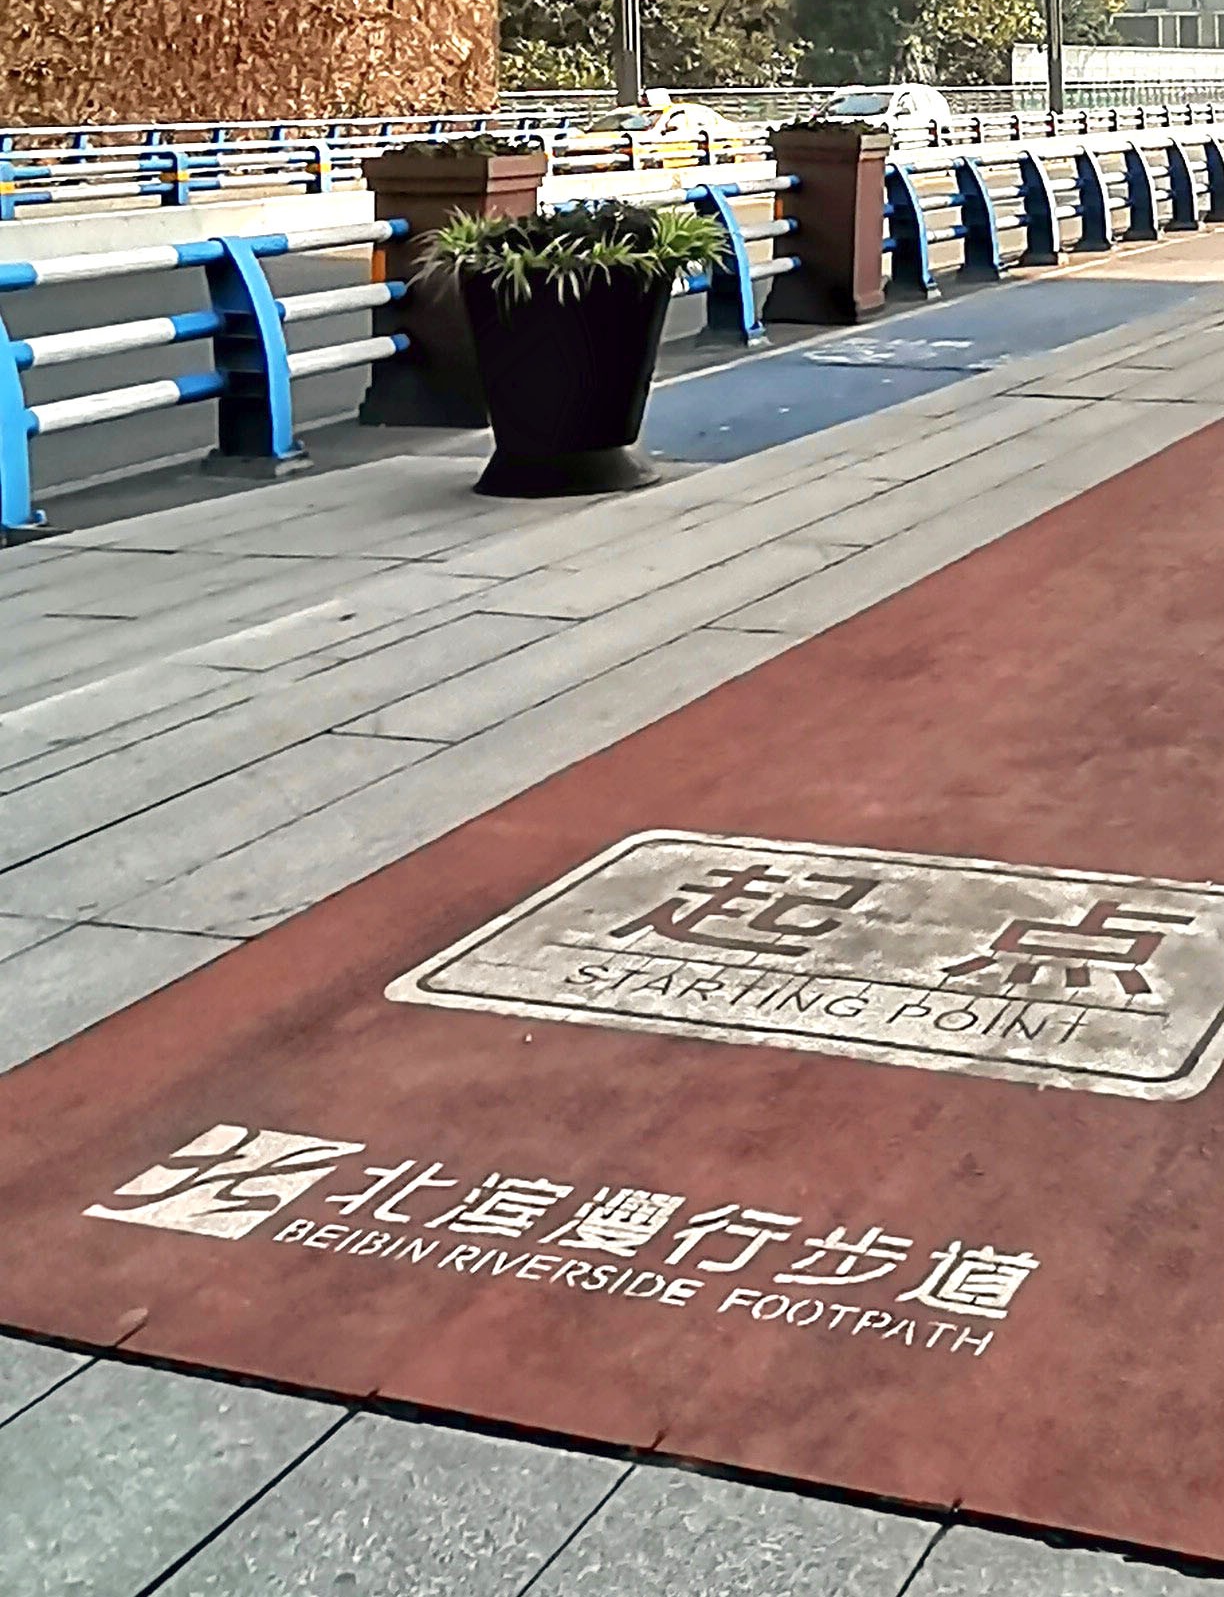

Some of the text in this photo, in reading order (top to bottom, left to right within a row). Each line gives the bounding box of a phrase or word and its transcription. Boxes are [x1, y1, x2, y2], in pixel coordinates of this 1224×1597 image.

[609, 864, 1197, 996] 起点
[564, 961, 1092, 1045] STARTING POINT
[272, 1218, 995, 1357] BEIBIN RIVERSIDE FOOTPATH
